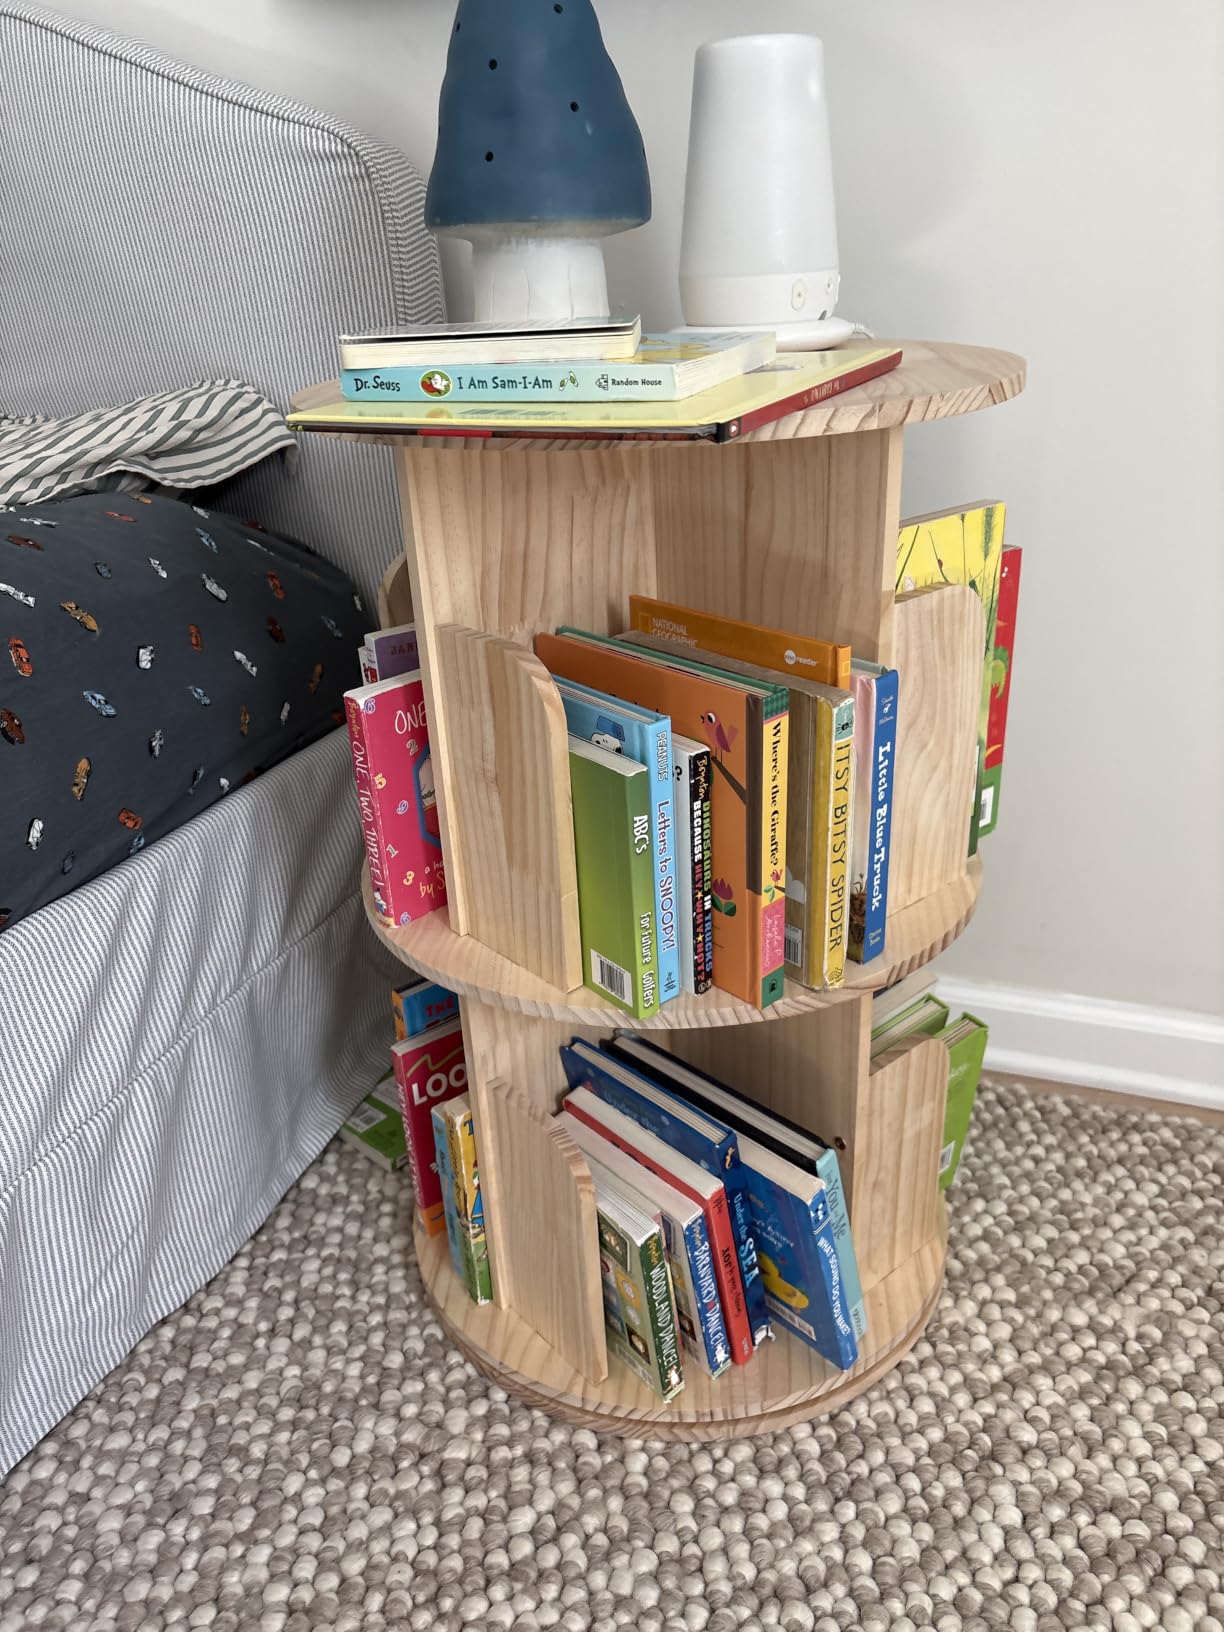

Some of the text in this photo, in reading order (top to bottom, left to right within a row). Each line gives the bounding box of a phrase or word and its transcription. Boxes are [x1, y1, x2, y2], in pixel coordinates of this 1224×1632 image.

[354, 375, 401, 392] Dr. Seuss
[457, 375, 553, 390] I Am Sam-I-Am
[611, 378, 662, 387] Random House
[652, 617, 688, 636] NATIONAL
[652, 629, 698, 648] GEOGRAPHIC
[796, 656, 818, 667] reader
[406, 739, 418, 756] 2
[657, 731, 668, 782] PEANUTS
[374, 774, 387, 790] 5
[695, 755, 709, 800] Boynton
[877, 741, 891, 802] Little
[770, 721, 782, 866] Where's the Giraffe?
[633, 815, 650, 854] ABC's
[693, 800, 703, 862] BECAUSE
[875, 803, 888, 849] Blue
[365, 827, 385, 887] THREE!
[829, 743, 851, 952] ITSY BITSY SPIDER
[403, 871, 415, 886] 3
[419, 881, 435, 899] by
[657, 800, 677, 952] Letters to SNOOPY!
[702, 800, 713, 973] DINOSAURS IN TRUCKS
[871, 847, 885, 912] Truck
[411, 1062, 469, 1107] LOO
[826, 1178, 839, 1211] You
[733, 1193, 760, 1288] Under the SEA
[817, 1237, 833, 1257] WHAT
[832, 1215, 846, 1241] Me
[829, 1254, 840, 1284] SOUND
[650, 1261, 672, 1326] WOODLAND
[694, 1241, 716, 1306] BARNYARD
[707, 1302, 724, 1346] DANCE!
[831, 1281, 840, 1300] DO
[832, 1299, 842, 1319] YOU
[658, 1321, 678, 1367] DANCE!
